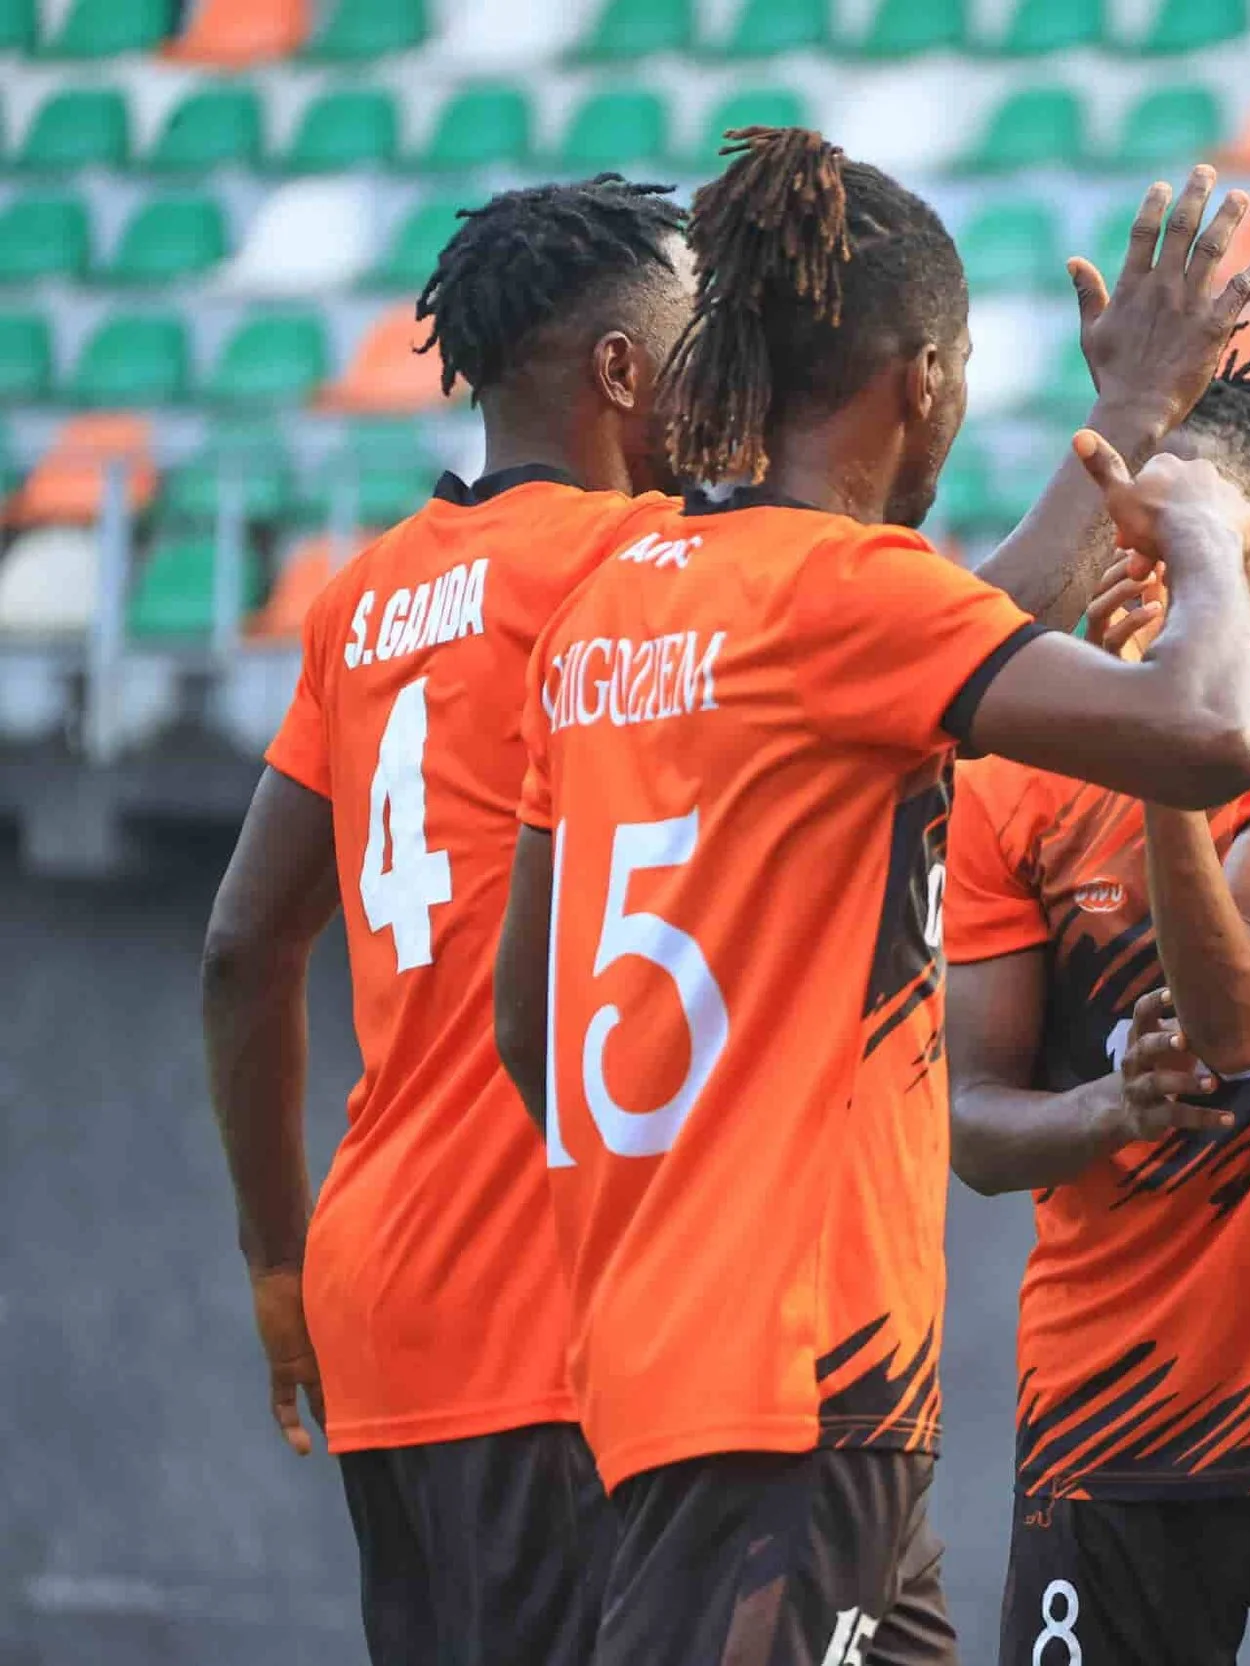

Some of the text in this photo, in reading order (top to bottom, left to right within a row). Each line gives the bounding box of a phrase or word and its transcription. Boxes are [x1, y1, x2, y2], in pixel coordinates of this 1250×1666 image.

[344, 557, 490, 670] S.GANDA
[359, 676, 452, 974] 4
[1033, 1579, 1082, 1666] 8
